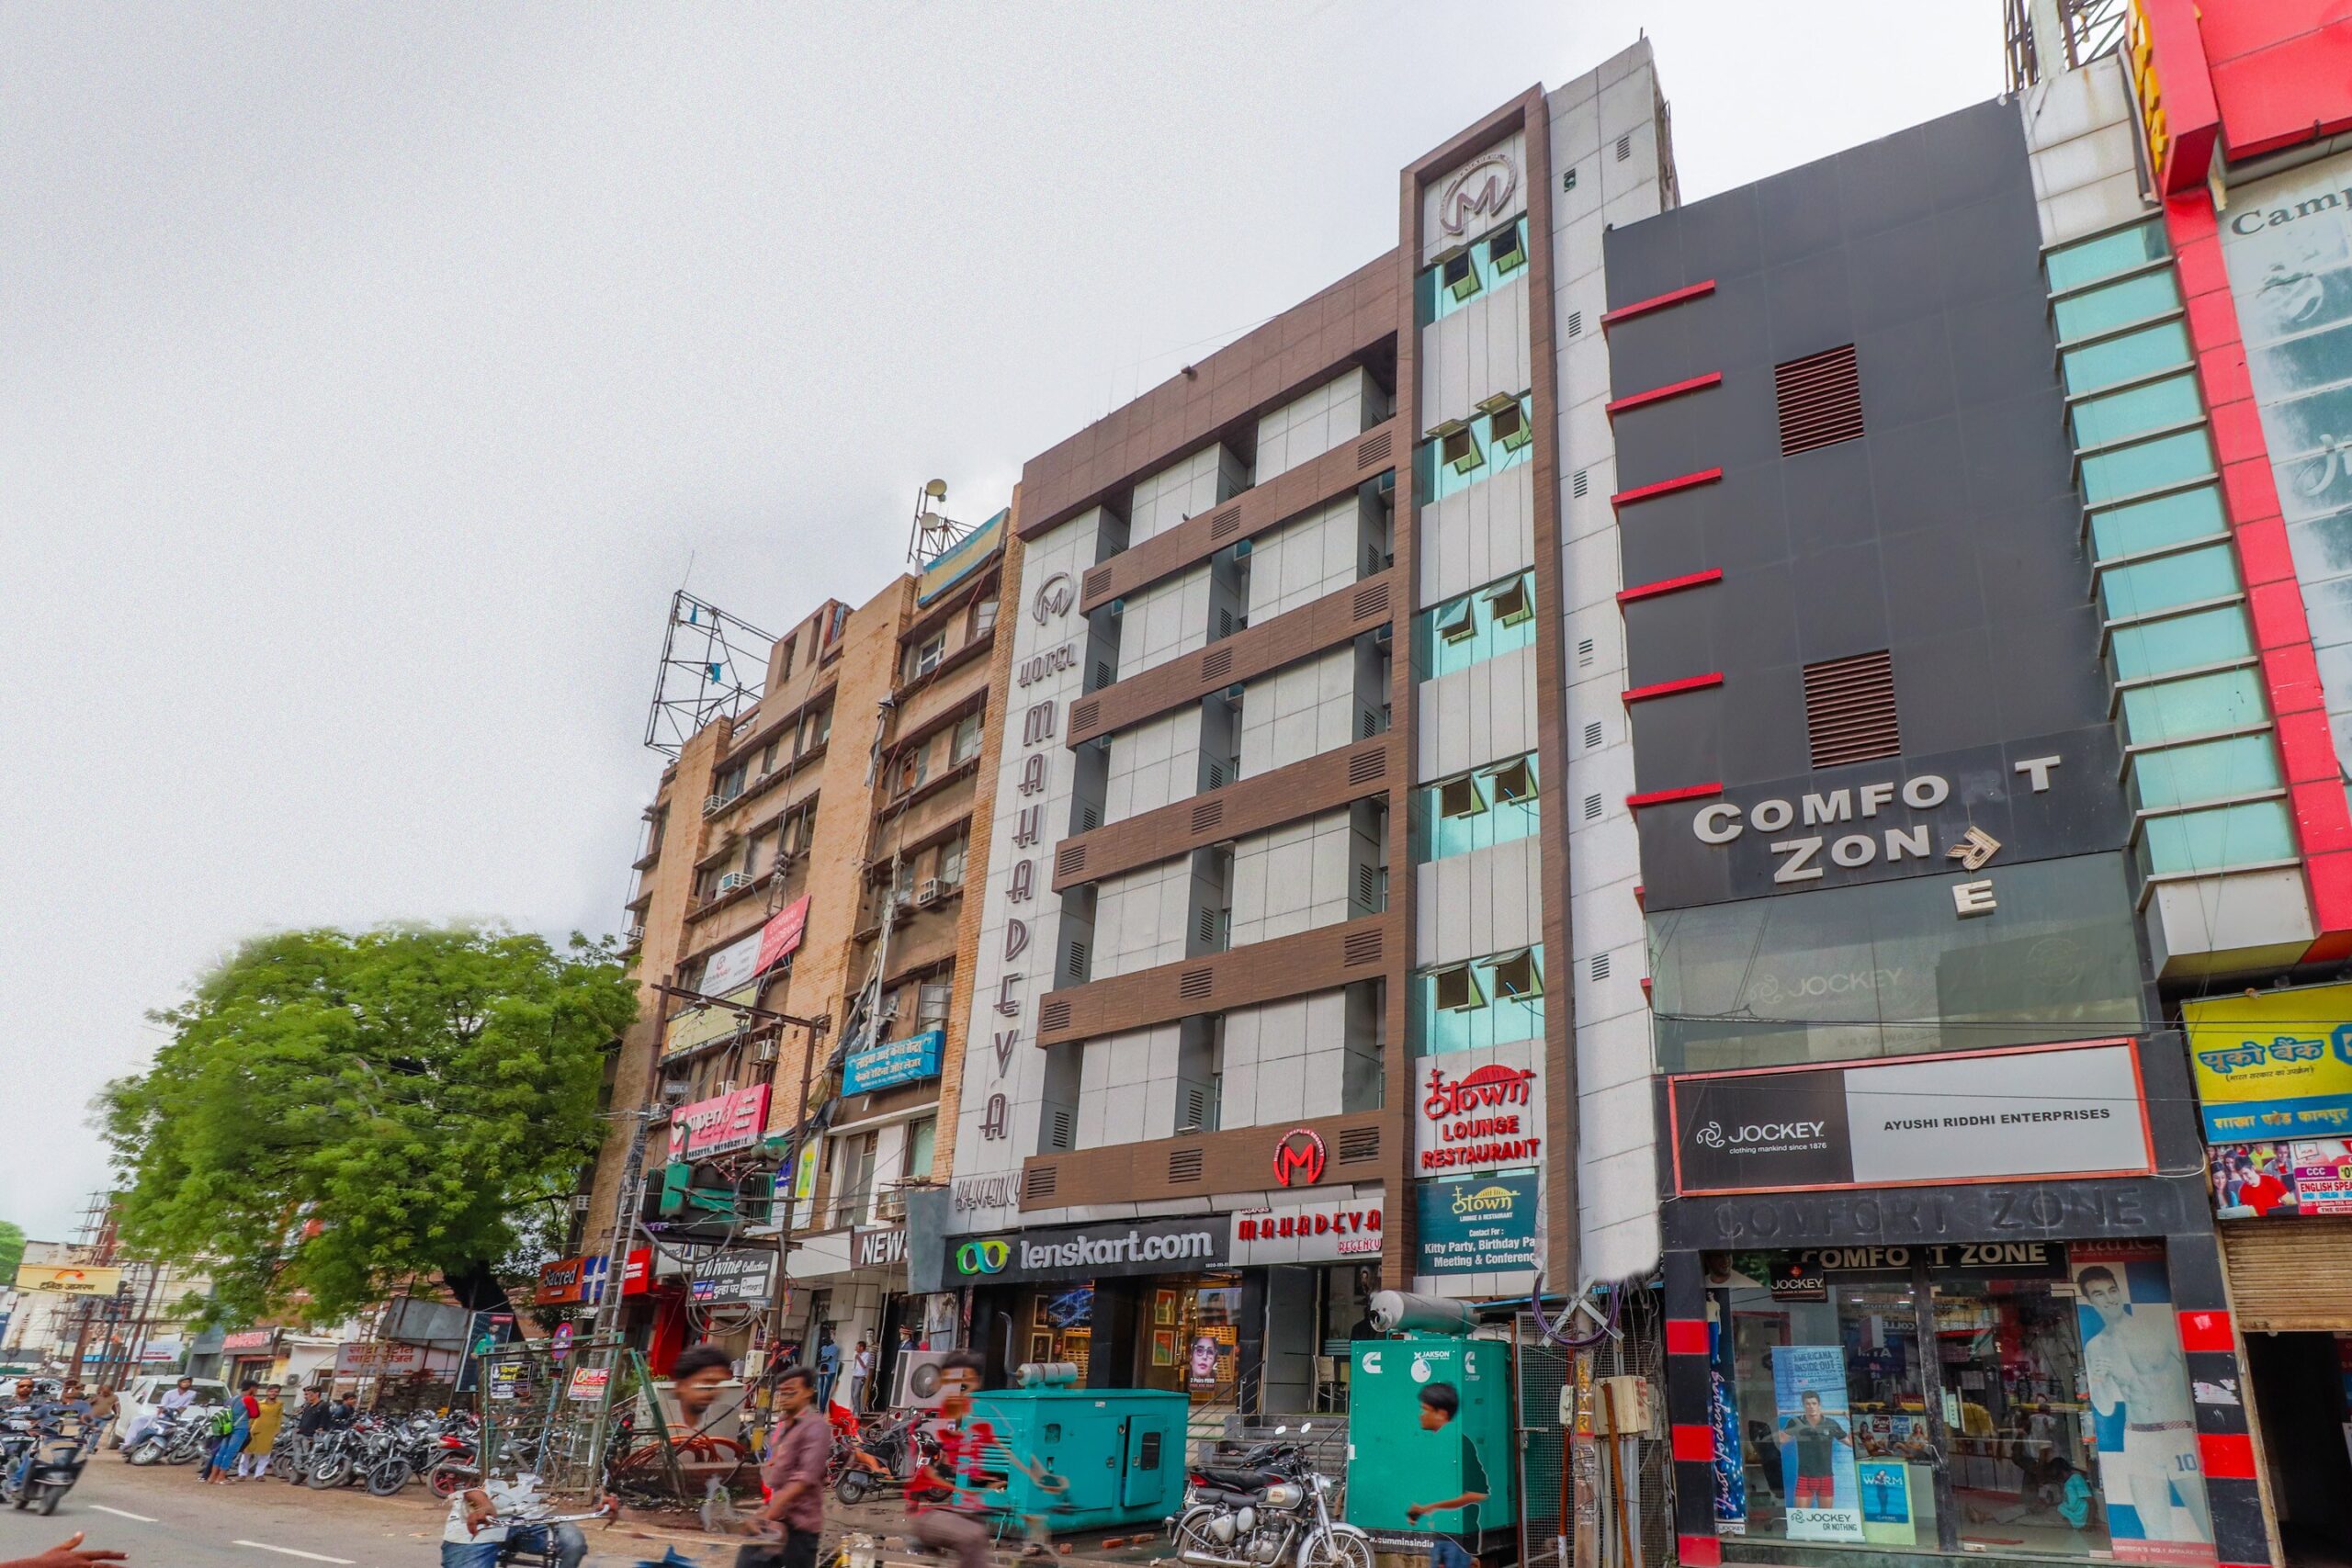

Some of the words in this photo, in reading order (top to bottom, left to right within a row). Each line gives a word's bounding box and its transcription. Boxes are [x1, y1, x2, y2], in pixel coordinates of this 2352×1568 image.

[1017, 644, 1076, 687] HOTEL
[1788, 968, 1903, 997] JOCKEY
[2198, 1042, 2265, 1073] यूको
[2268, 1037, 2324, 1062] बैंक
[2249, 1071, 2273, 1079] सरकार
[1442, 1114, 1520, 1141] LOUNGE
[1884, 1119, 1939, 1131] AYUSHI
[1944, 1115, 1996, 1127] RIDDHI
[2001, 1109, 2110, 1123] ENTERPRISES
[2213, 1116, 2255, 1130] शाखा
[2298, 1108, 2348, 1126] कानपुर
[1728, 1122, 1825, 1143] JOCKEY
[1421, 1138, 1540, 1168] RESTAURANT
[2306, 1168, 2325, 1176] CCC
[2301, 1182, 2332, 1192] ENGLISH
[1990, 1188, 2146, 1230] ZONE
[1238, 1209, 1382, 1240] MAHADEVA
[1469, 1229, 1489, 1237] Contact
[861, 1230, 908, 1264] NEW
[1020, 1231, 1214, 1269] lenskart.com
[1425, 1243, 1445, 1254] Kitty
[1449, 1241, 1476, 1252] Party,
[1478, 1237, 1520, 1249] Birthday
[1522, 1236, 1535, 1247] Pa
[1961, 1244, 2047, 1265] ZONE
[704, 1257, 742, 1278] Divine
[1434, 1256, 1472, 1268] Meeting
[1475, 1255, 1483, 1265] &
[1486, 1252, 1535, 1264] Conferenc
[544, 1264, 578, 1287] Sacred
[1771, 1278, 1824, 1289] JOCKEY
[1819, 1360, 1835, 1370] OUT
[2175, 1454, 2197, 1472] 10
[1806, 1514, 1851, 1523] JOCKEY
[1831, 1522, 1857, 1531] NOTHING
